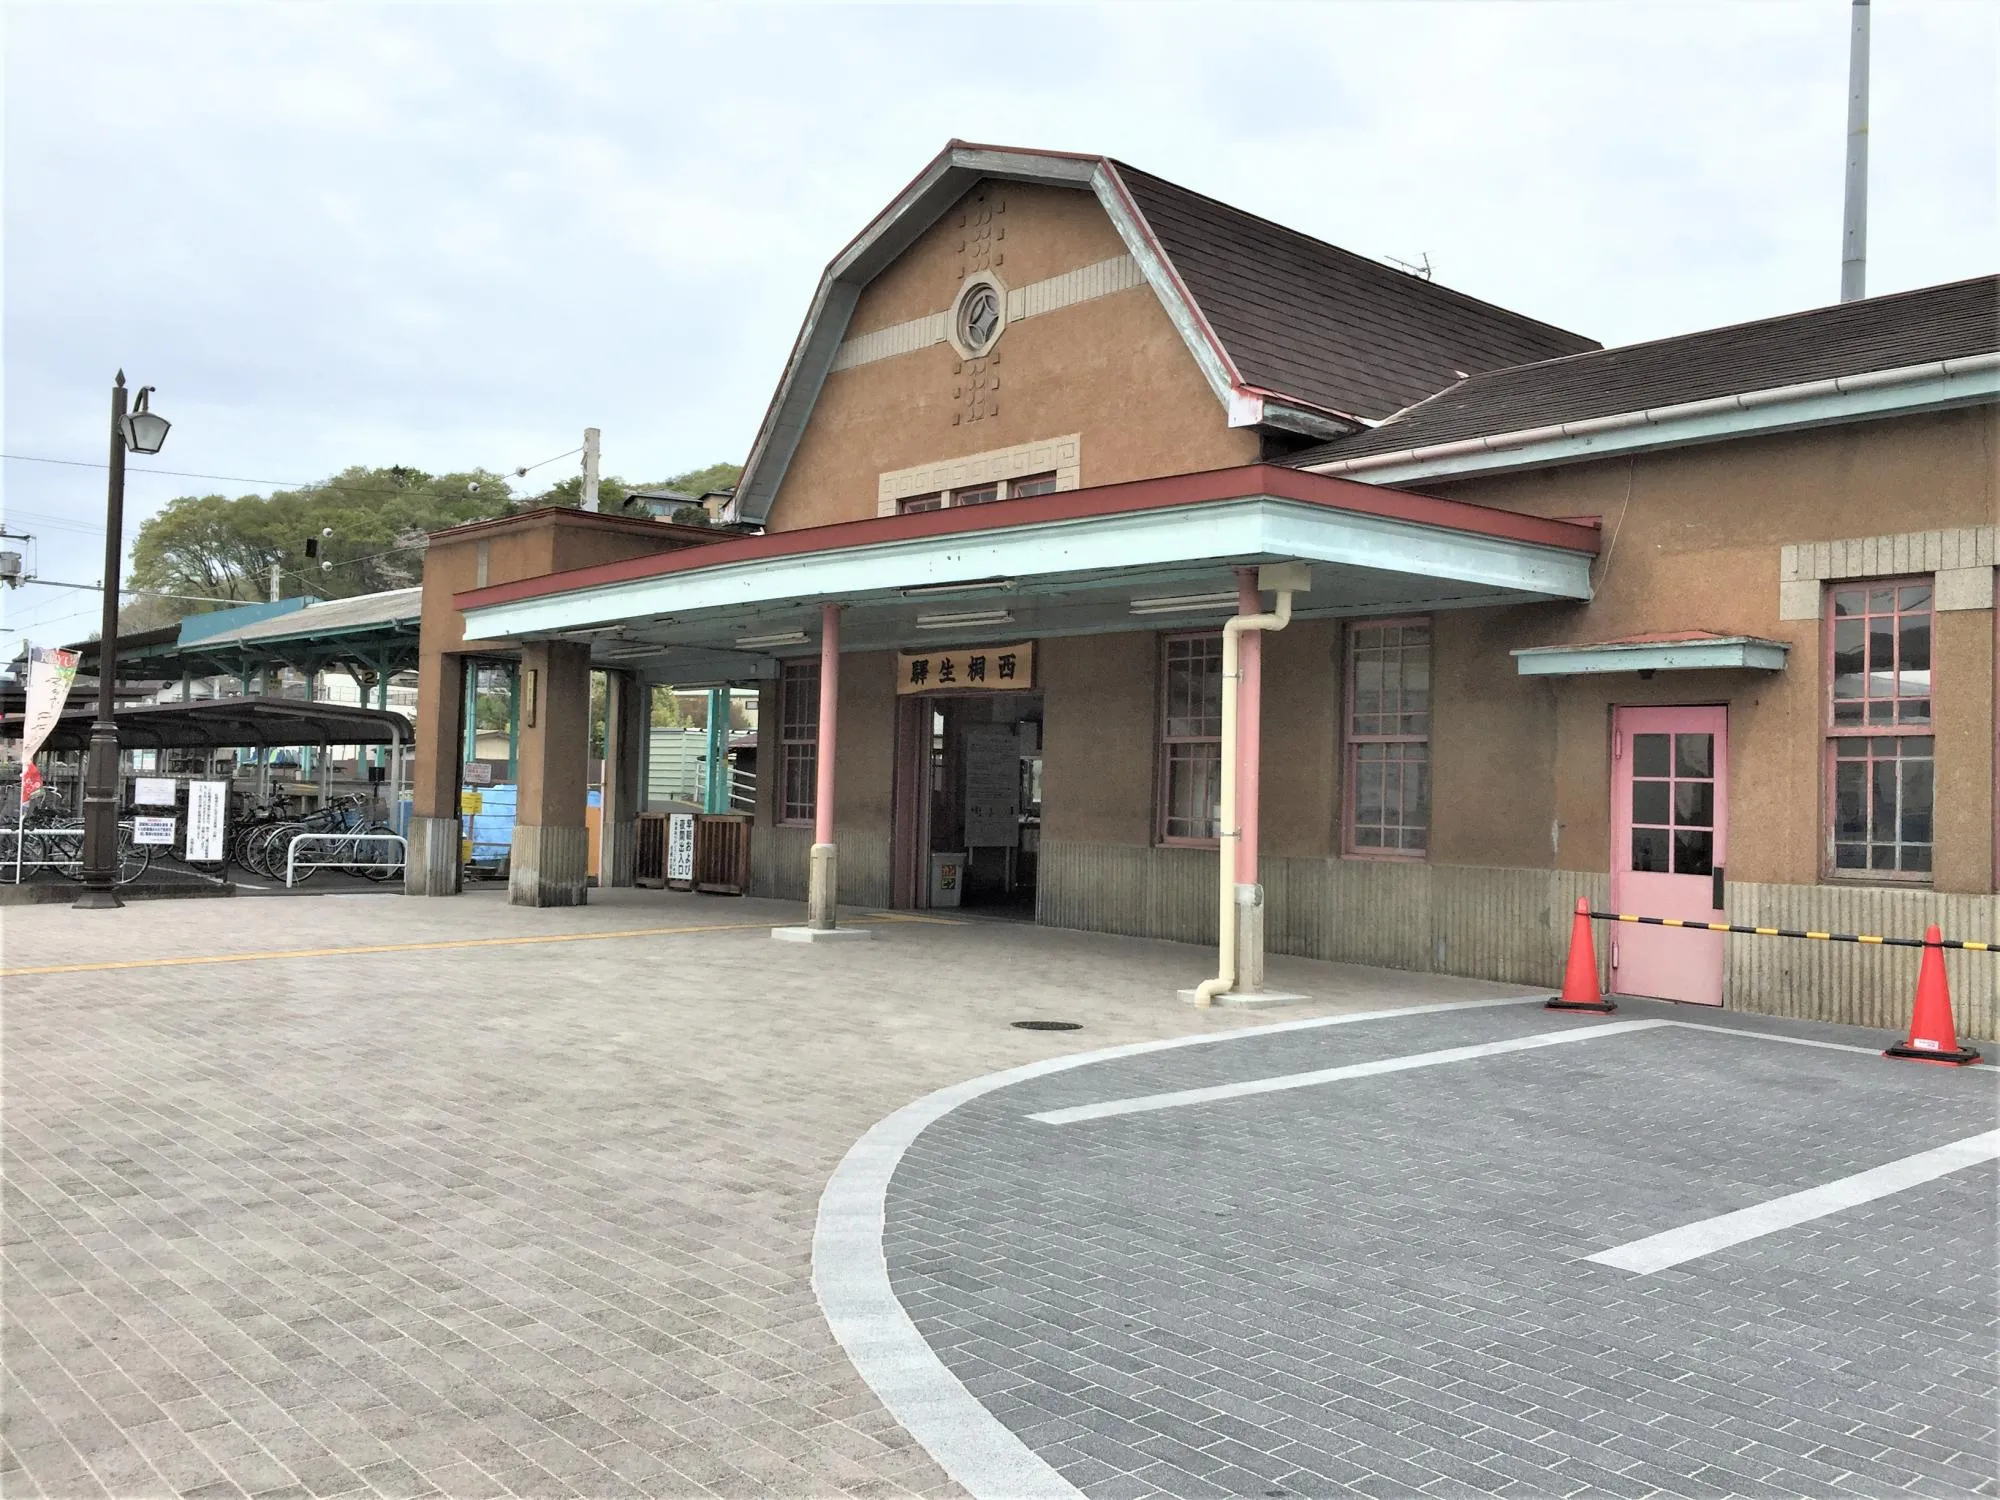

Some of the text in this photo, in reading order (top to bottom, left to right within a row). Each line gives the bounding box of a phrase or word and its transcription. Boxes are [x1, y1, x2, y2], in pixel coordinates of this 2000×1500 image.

[365, 672, 376, 684] 2
[684, 819, 692, 875] 早朝および
